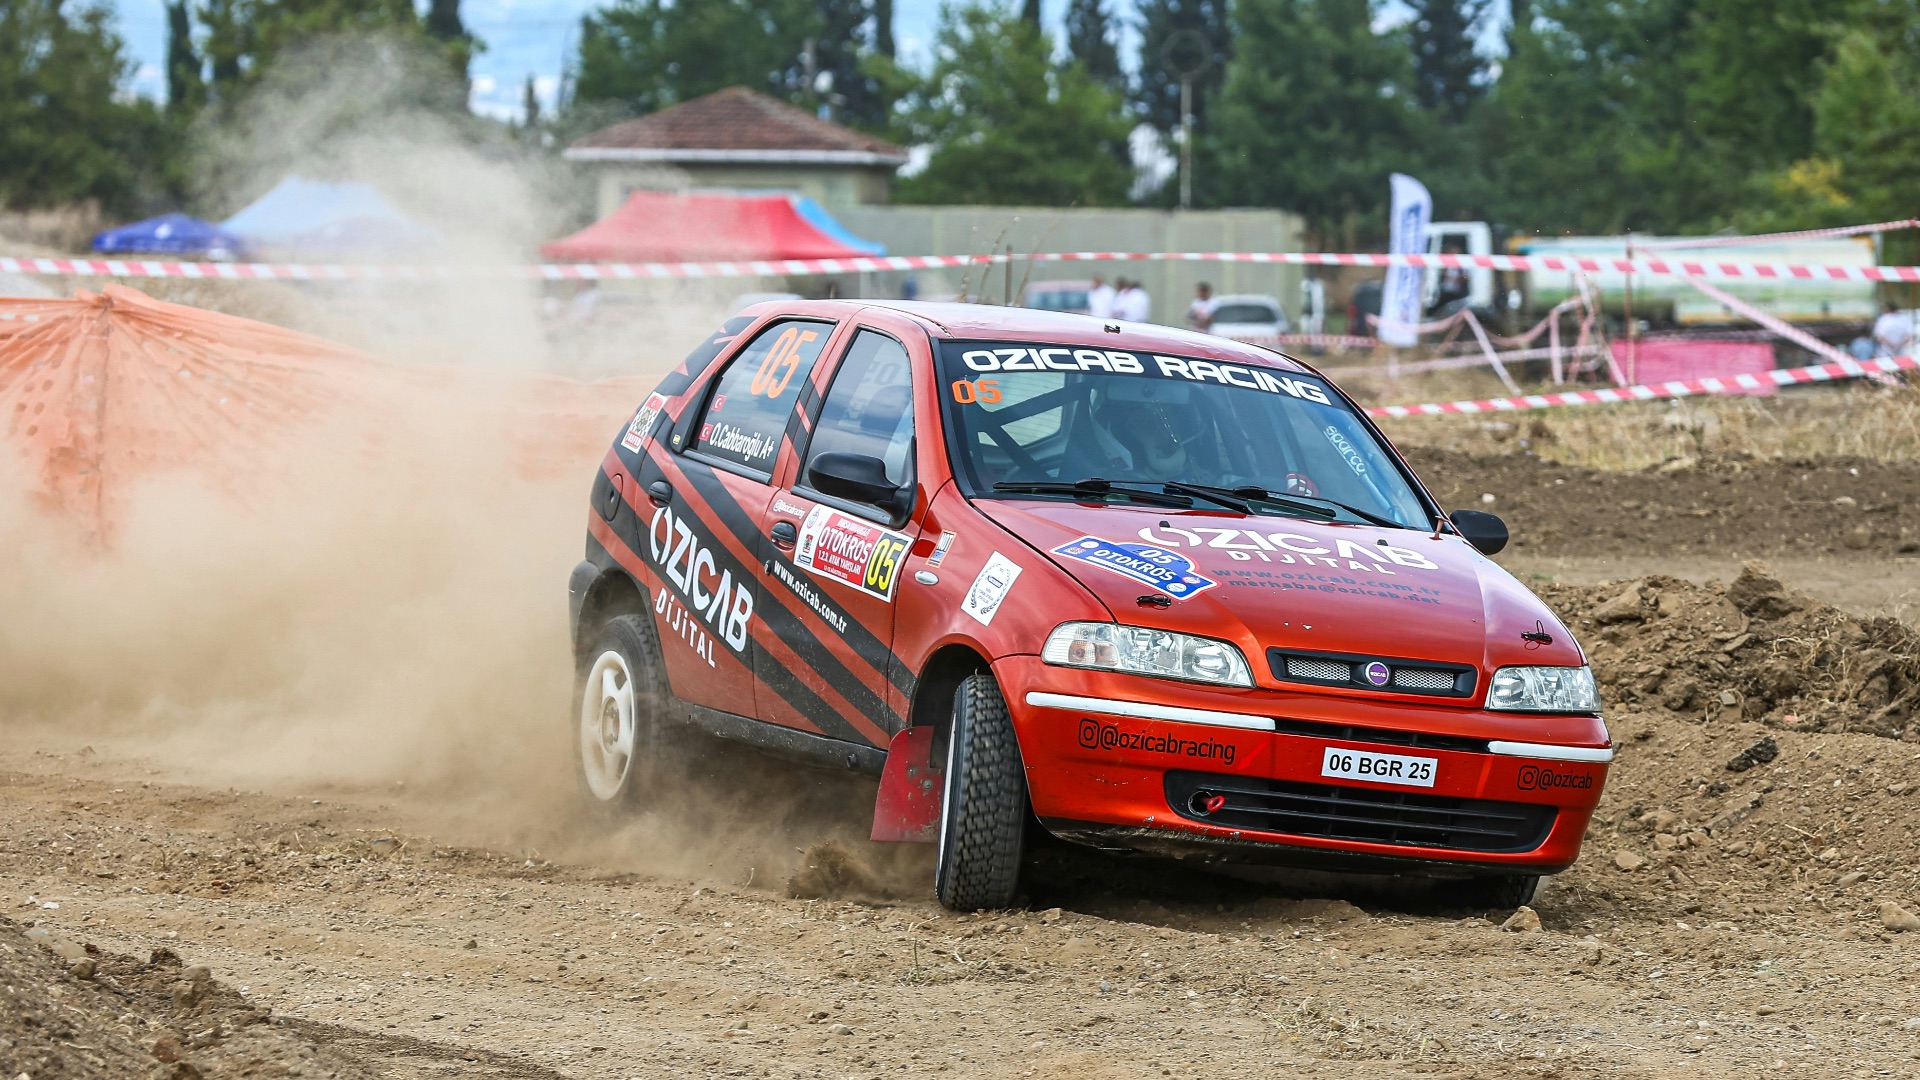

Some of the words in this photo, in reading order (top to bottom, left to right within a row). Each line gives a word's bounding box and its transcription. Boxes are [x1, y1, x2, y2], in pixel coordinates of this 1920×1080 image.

[751, 327, 819, 399] 05
[962, 348, 1145, 374] OZICAB
[1152, 355, 1332, 406] RACING
[951, 379, 1003, 404] 05
[758, 436, 775, 460] A+
[1323, 425, 1366, 476] sparco
[818, 526, 873, 564] OTOKROS
[1137, 527, 1439, 571] OZICAB
[1138, 549, 1179, 564] 05
[650, 506, 754, 653] OZICAB
[867, 538, 905, 591] 05
[1093, 549, 1178, 581] OTOKROS
[1212, 569, 1441, 596] www.ozicab.com.tr
[774, 560, 848, 634] www.ozicab.com.tr
[1229, 578, 1441, 605] merhaba@ozicab.net
[1100, 725, 1236, 766] @ozicabracing
[1329, 754, 1353, 773] 06
[1358, 757, 1403, 778] BGR
[1408, 762, 1431, 780] 25
[1539, 768, 1593, 791] @ozicab
